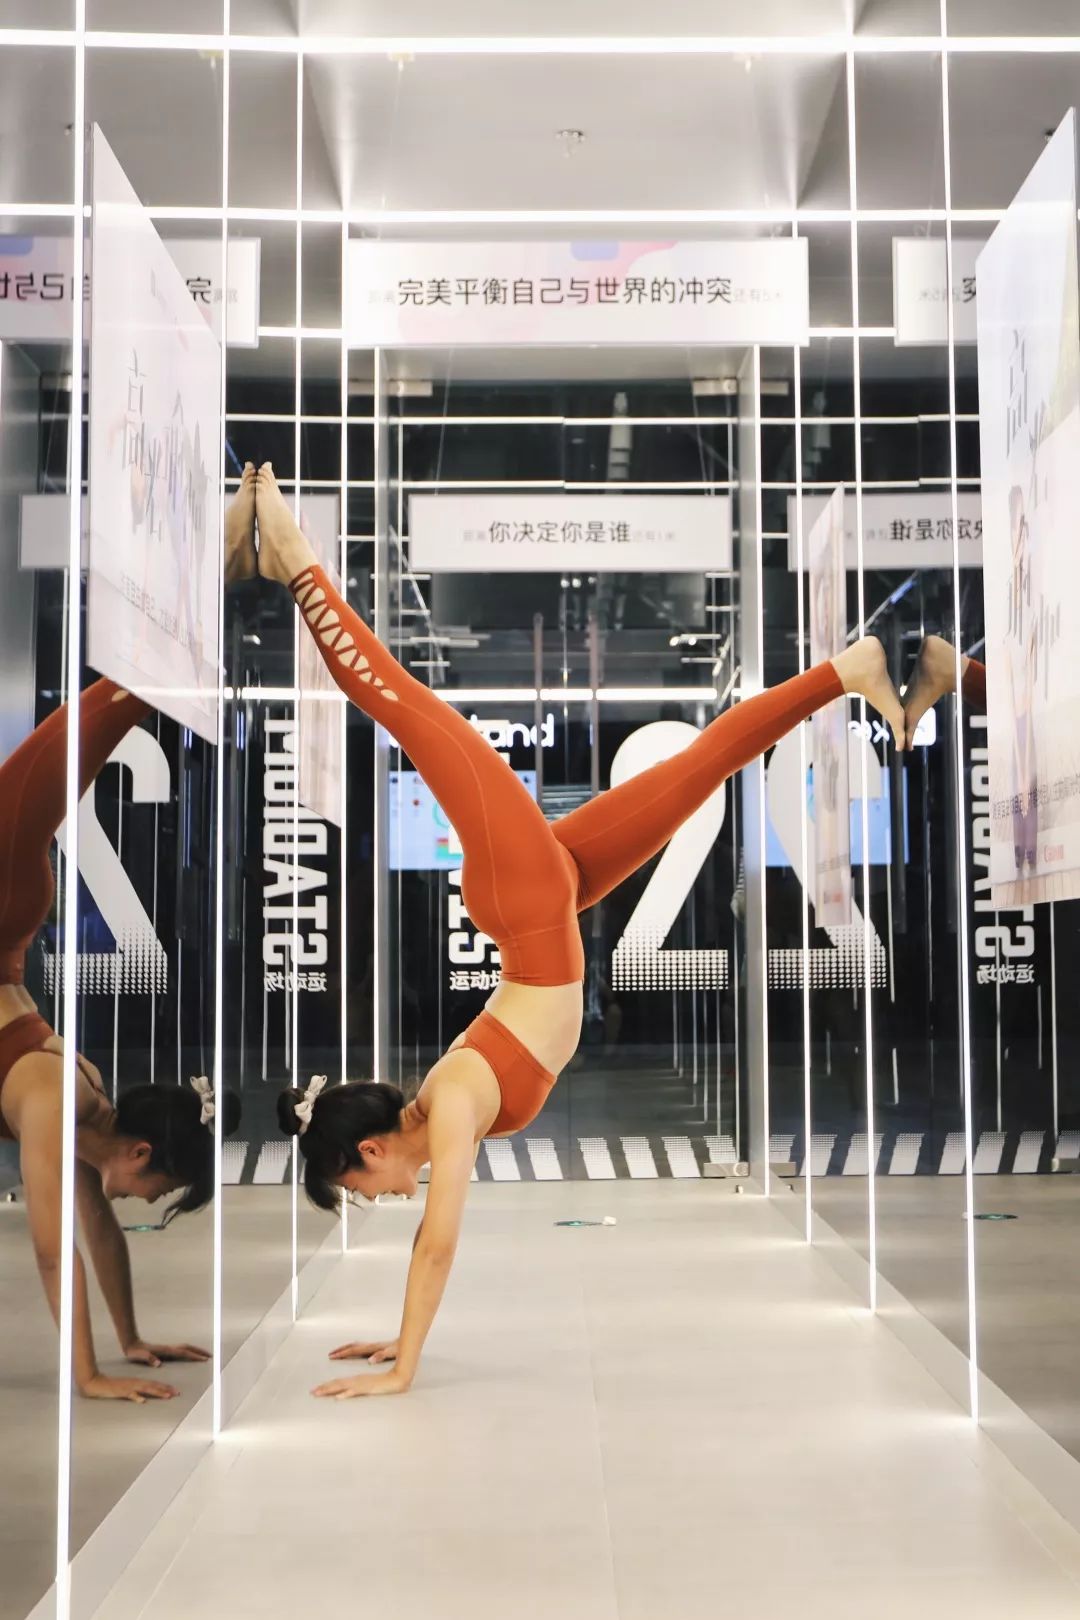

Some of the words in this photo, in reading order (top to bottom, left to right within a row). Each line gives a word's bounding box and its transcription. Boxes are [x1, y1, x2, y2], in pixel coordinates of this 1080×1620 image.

[398, 277, 731, 305] 完美平衡自己与世界的冲突
[488, 520, 631, 543] 你决定你是谁
